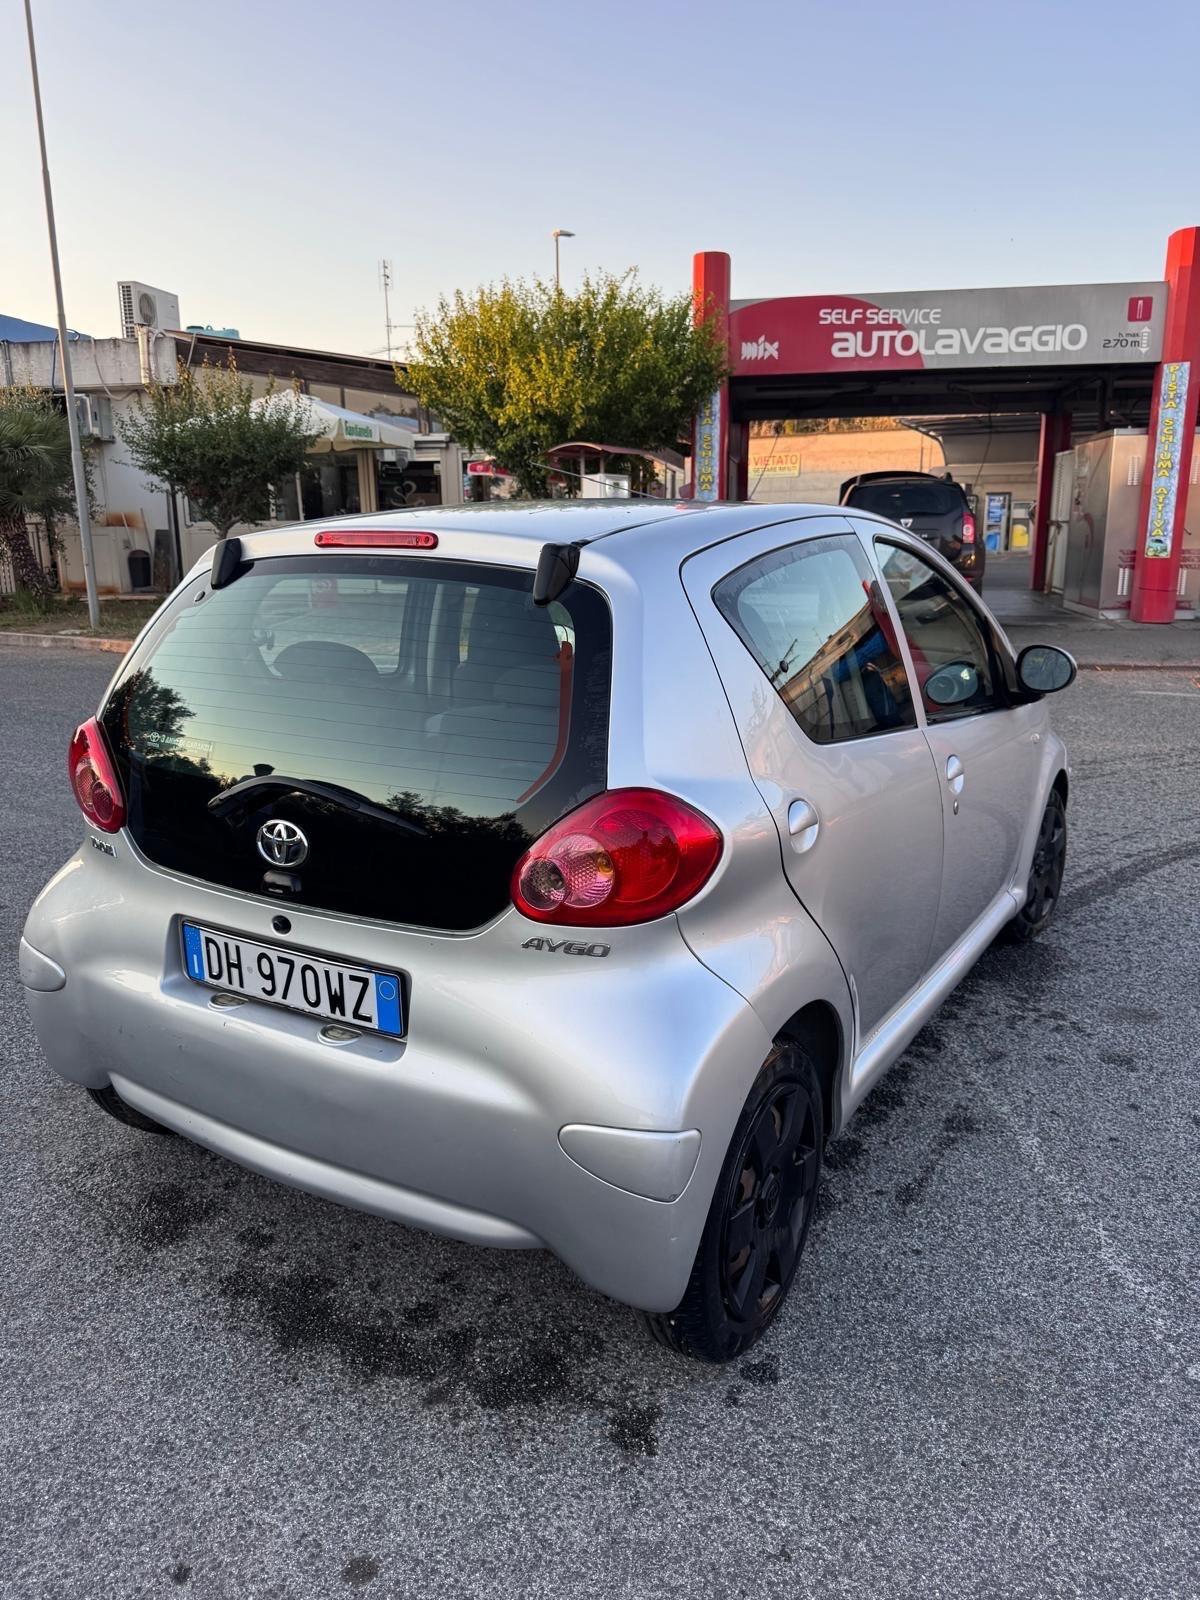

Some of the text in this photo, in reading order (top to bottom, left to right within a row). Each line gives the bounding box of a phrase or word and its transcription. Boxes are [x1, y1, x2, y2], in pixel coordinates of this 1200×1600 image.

[819, 308, 942, 325] SELF SERVICE
[741, 334, 780, 361] mix
[1130, 340, 1140, 348] m
[700, 434, 713, 491] SCHIUMA
[752, 454, 798, 466] VIETATO
[1151, 364, 1180, 537] PISTA SCHIUMA ATTIVA
[520, 936, 611, 957] AYGO
[204, 936, 373, 1023] DH 970WZ
